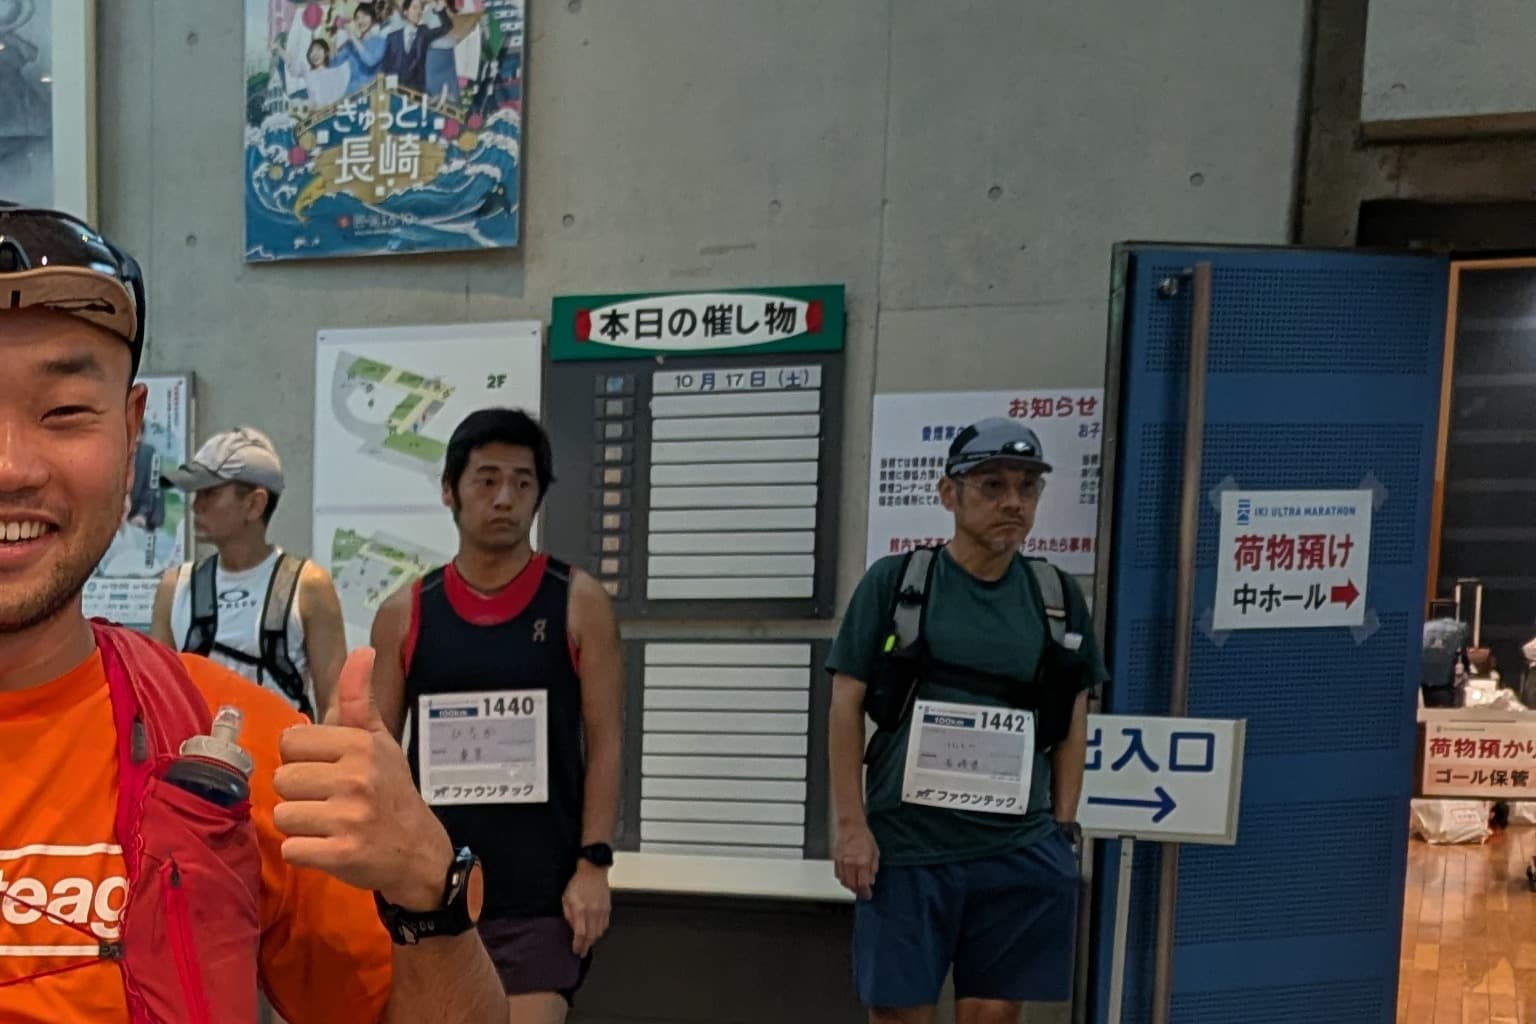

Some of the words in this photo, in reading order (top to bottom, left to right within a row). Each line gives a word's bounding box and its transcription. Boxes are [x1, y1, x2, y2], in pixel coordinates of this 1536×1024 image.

[332, 93, 428, 133] ぎゅっと!
[334, 134, 422, 185] 長崎
[599, 302, 797, 341] 本日の催し物
[486, 374, 507, 389] 2F
[1008, 396, 1097, 418] お知らせ
[1272, 507, 1300, 517] ULTRA
[1304, 506, 1356, 516] MARATHON
[1234, 533, 1354, 572] 荷物預け
[1233, 583, 1326, 614] 中ホール
[483, 697, 534, 716] 1440
[981, 712, 1025, 732] 1442
[1436, 769, 1529, 787] ゴール保管
[452, 784, 534, 798] ファウンテック
[937, 790, 1017, 808] ファウンテック
